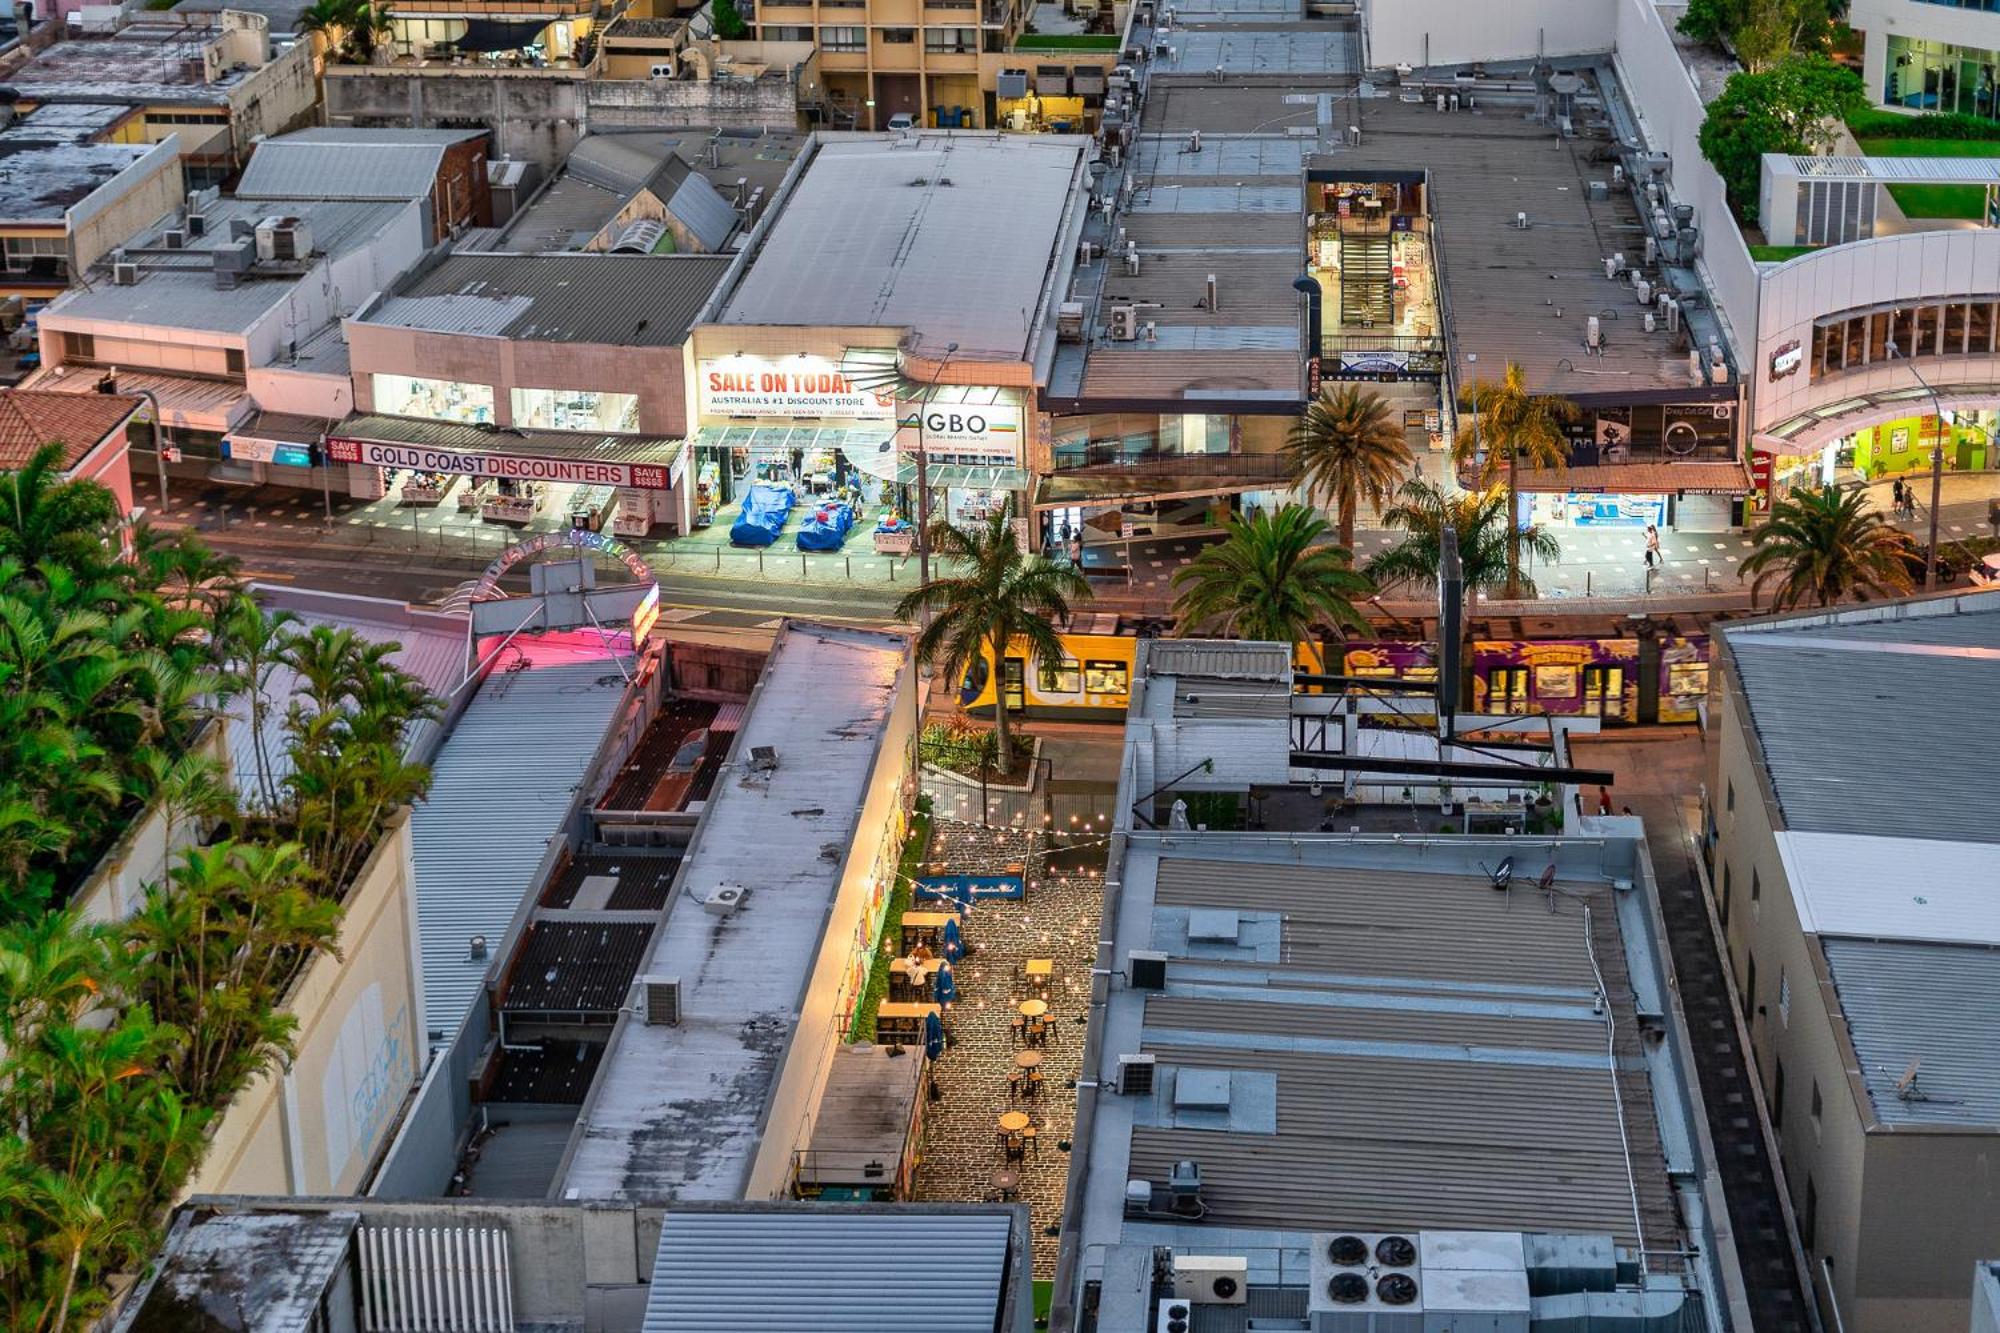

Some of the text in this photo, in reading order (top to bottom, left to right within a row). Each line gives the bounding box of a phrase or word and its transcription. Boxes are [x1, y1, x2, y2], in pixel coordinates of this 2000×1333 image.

[709, 372, 755, 393] SALE
[761, 373, 788, 393] ON
[792, 373, 855, 394] TODAY
[787, 398, 834, 406] DISCOUNT
[835, 398, 865, 406] STORE
[927, 413, 986, 434] GBO
[331, 441, 357, 452] SAVE
[370, 446, 623, 483] GOLD COAST DISCOUNTERS
[634, 468, 662, 478] SAVE
